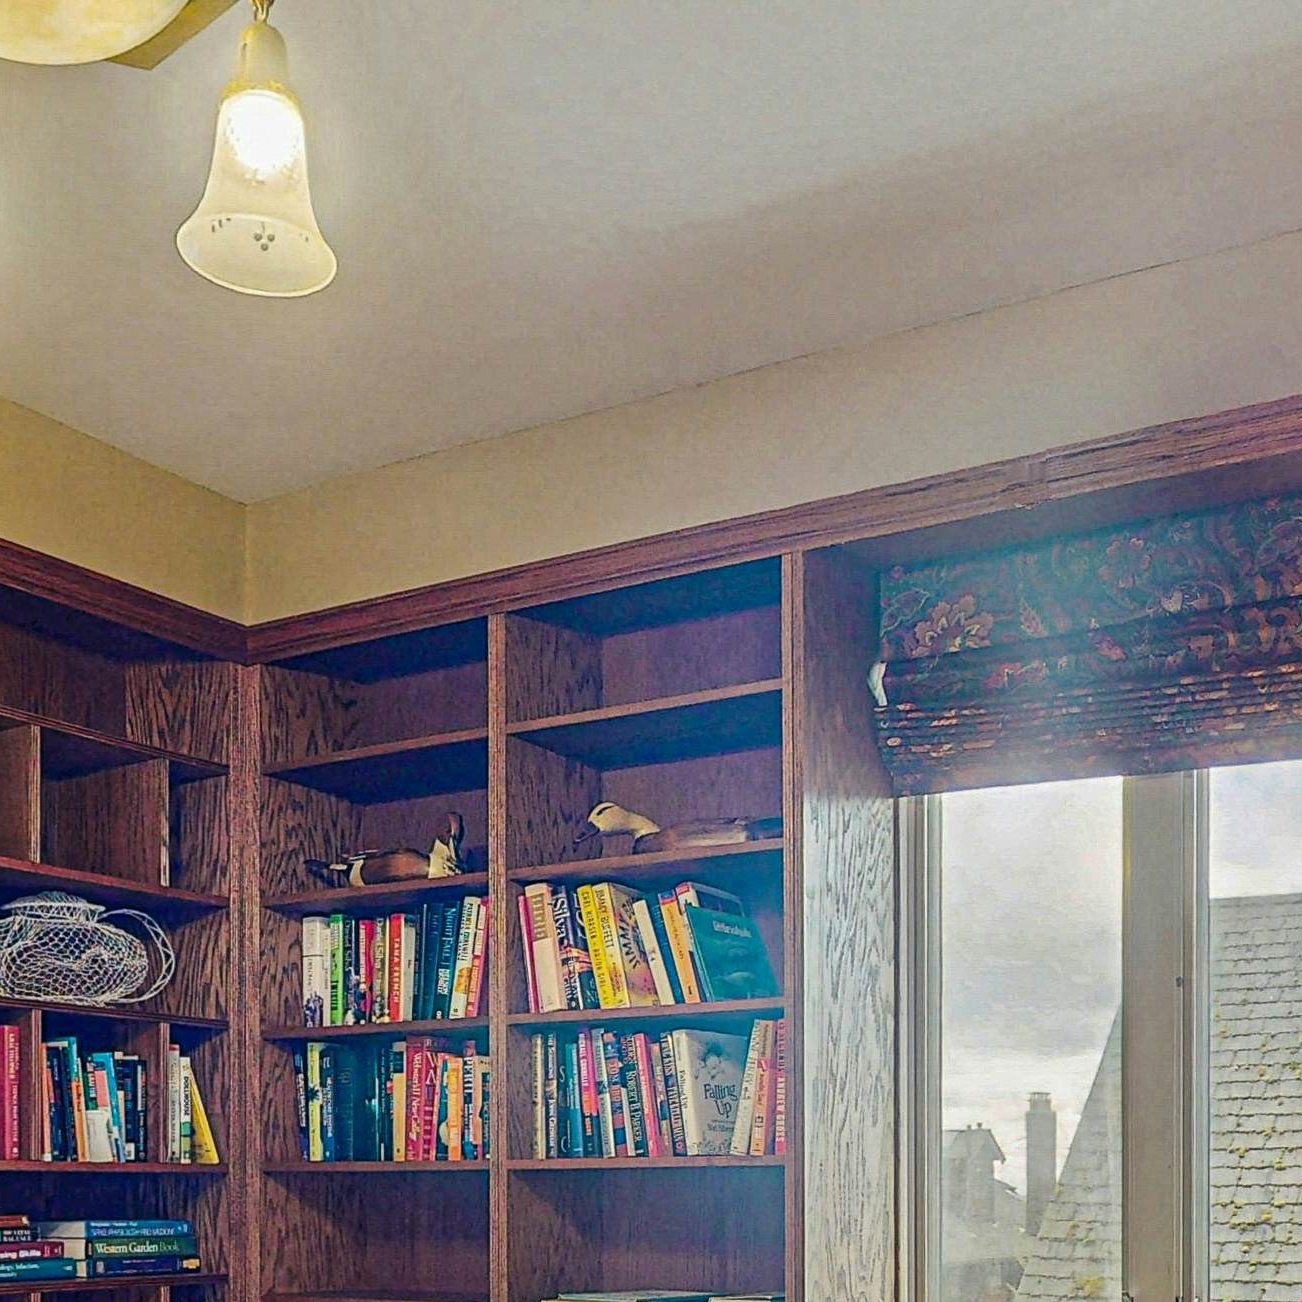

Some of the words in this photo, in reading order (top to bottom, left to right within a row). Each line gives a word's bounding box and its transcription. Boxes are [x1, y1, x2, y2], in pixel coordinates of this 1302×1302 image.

[463, 903, 474, 930] PATRICIA
[552, 898, 571, 939] Silva
[582, 891, 592, 909] CARL
[596, 972, 606, 989] GIRL
[601, 916, 614, 950] BUFFETT
[392, 967, 400, 1003] FRENCH
[625, 1070, 638, 1103] ROBERT
[703, 1083, 738, 1101] Falling
[776, 1077, 787, 1112] ANDREW
[714, 1100, 732, 1118] Up
[630, 1111, 643, 1142] PARKER
[776, 1114, 787, 1142] GROSS
[18, 1249, 42, 1258] Skills
[94, 1242, 128, 1254] Western
[128, 1240, 159, 1254] Garden
[159, 1240, 180, 1252] Book
